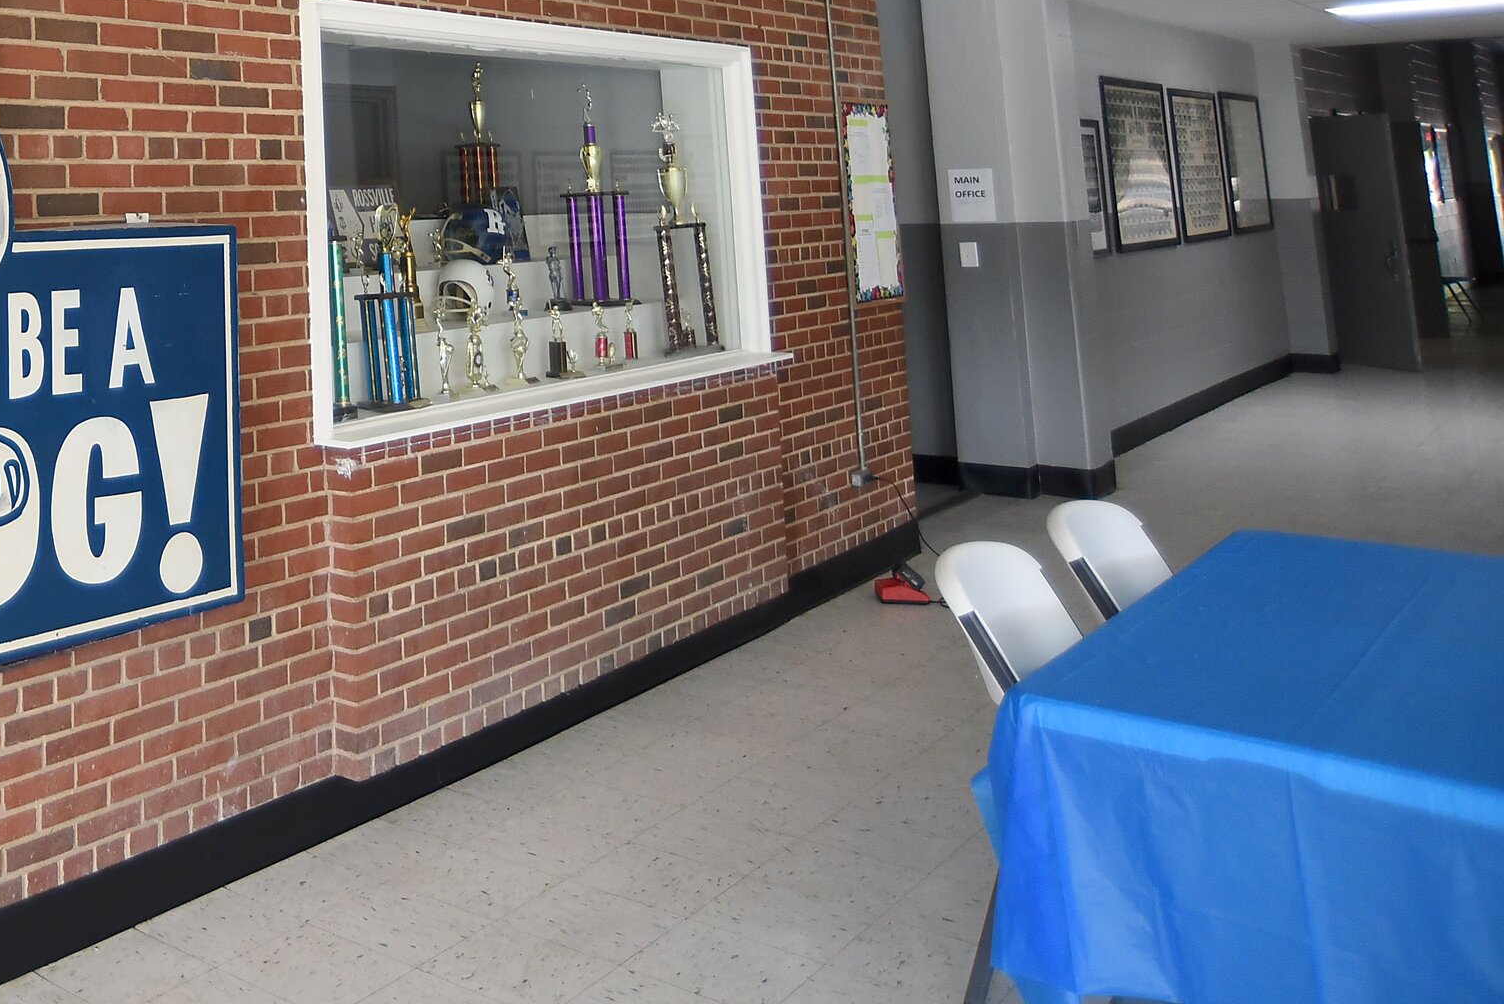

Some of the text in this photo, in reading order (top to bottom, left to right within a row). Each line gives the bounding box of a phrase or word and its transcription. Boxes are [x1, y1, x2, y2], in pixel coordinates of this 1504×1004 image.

[954, 176, 980, 184] MAIN
[351, 187, 395, 208] ROSSVILLE
[955, 190, 986, 198] OFFICE
[483, 208, 506, 235] R
[8, 289, 83, 400] BE
[108, 287, 156, 390] A
